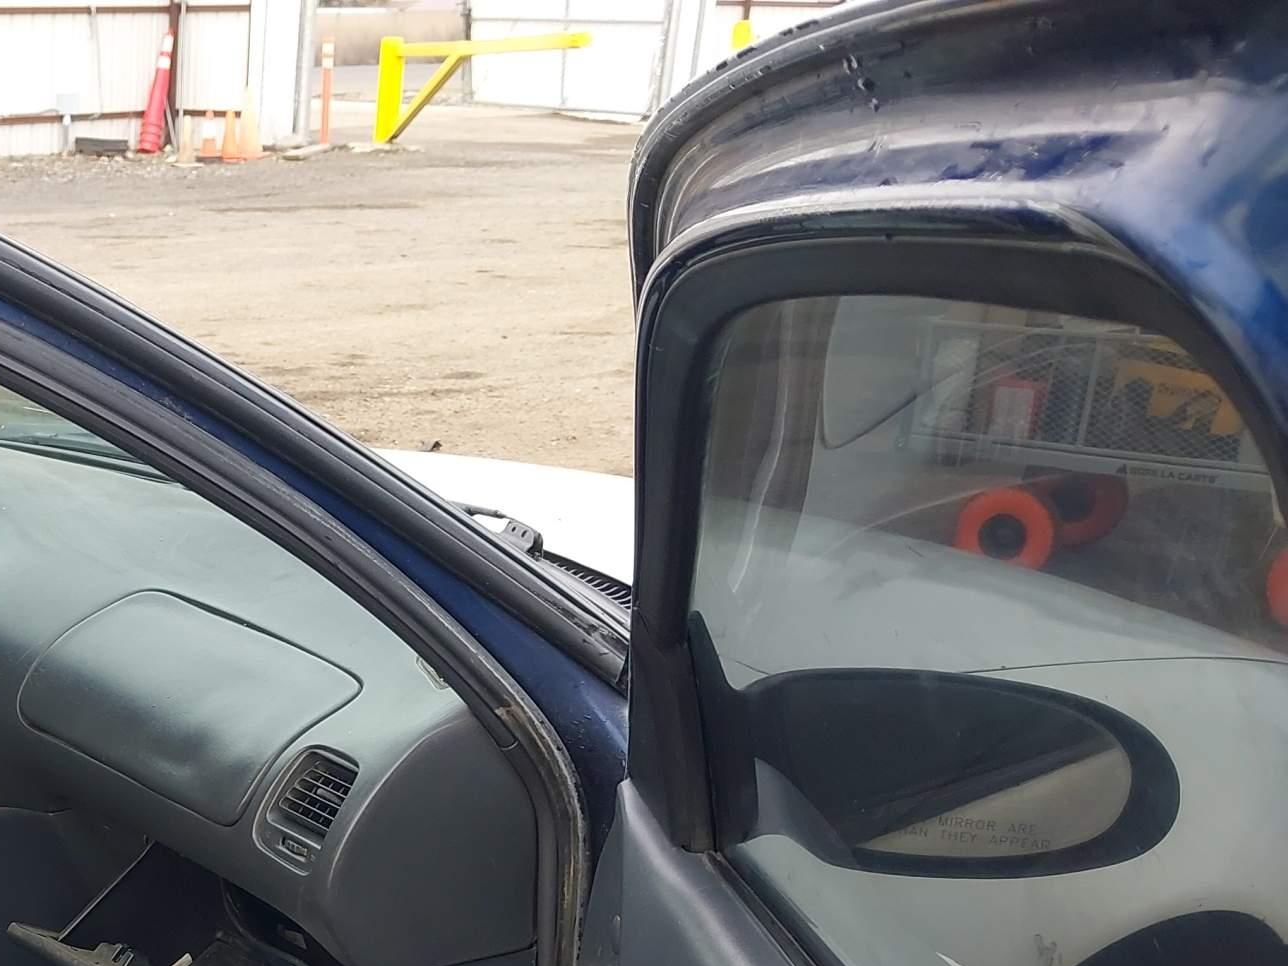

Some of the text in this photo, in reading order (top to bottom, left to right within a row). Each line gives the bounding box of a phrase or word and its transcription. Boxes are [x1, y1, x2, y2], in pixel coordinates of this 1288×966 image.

[938, 815, 1038, 835] MIRROR ARE
[940, 830, 977, 844] THEY
[989, 834, 1051, 850] APPEAR
